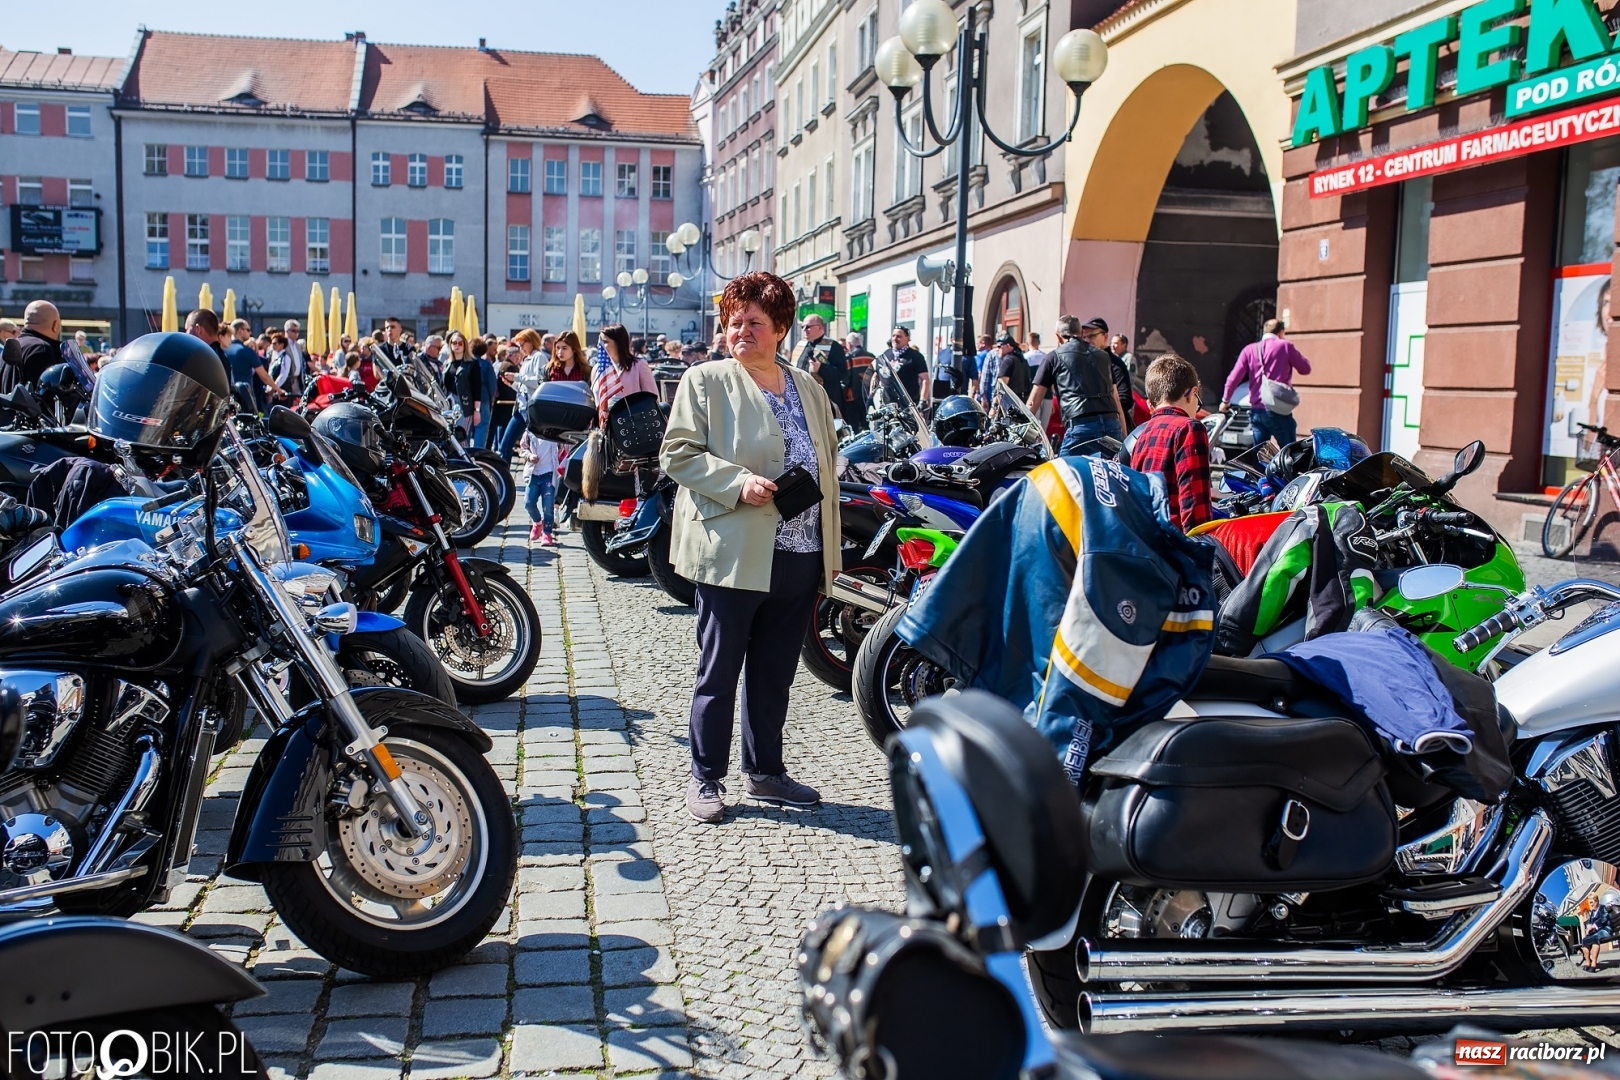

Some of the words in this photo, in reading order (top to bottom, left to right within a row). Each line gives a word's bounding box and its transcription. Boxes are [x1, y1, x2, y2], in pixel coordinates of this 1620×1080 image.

[1292, 0, 1620, 147] APTEK
[1515, 76, 1569, 110] POD
[1313, 169, 1355, 195] RYNEK
[1357, 163, 1374, 184] 12
[1384, 143, 1457, 177] CENTRUM
[135, 509, 182, 528] YAMAH
[1063, 718, 1094, 787] REBEL
